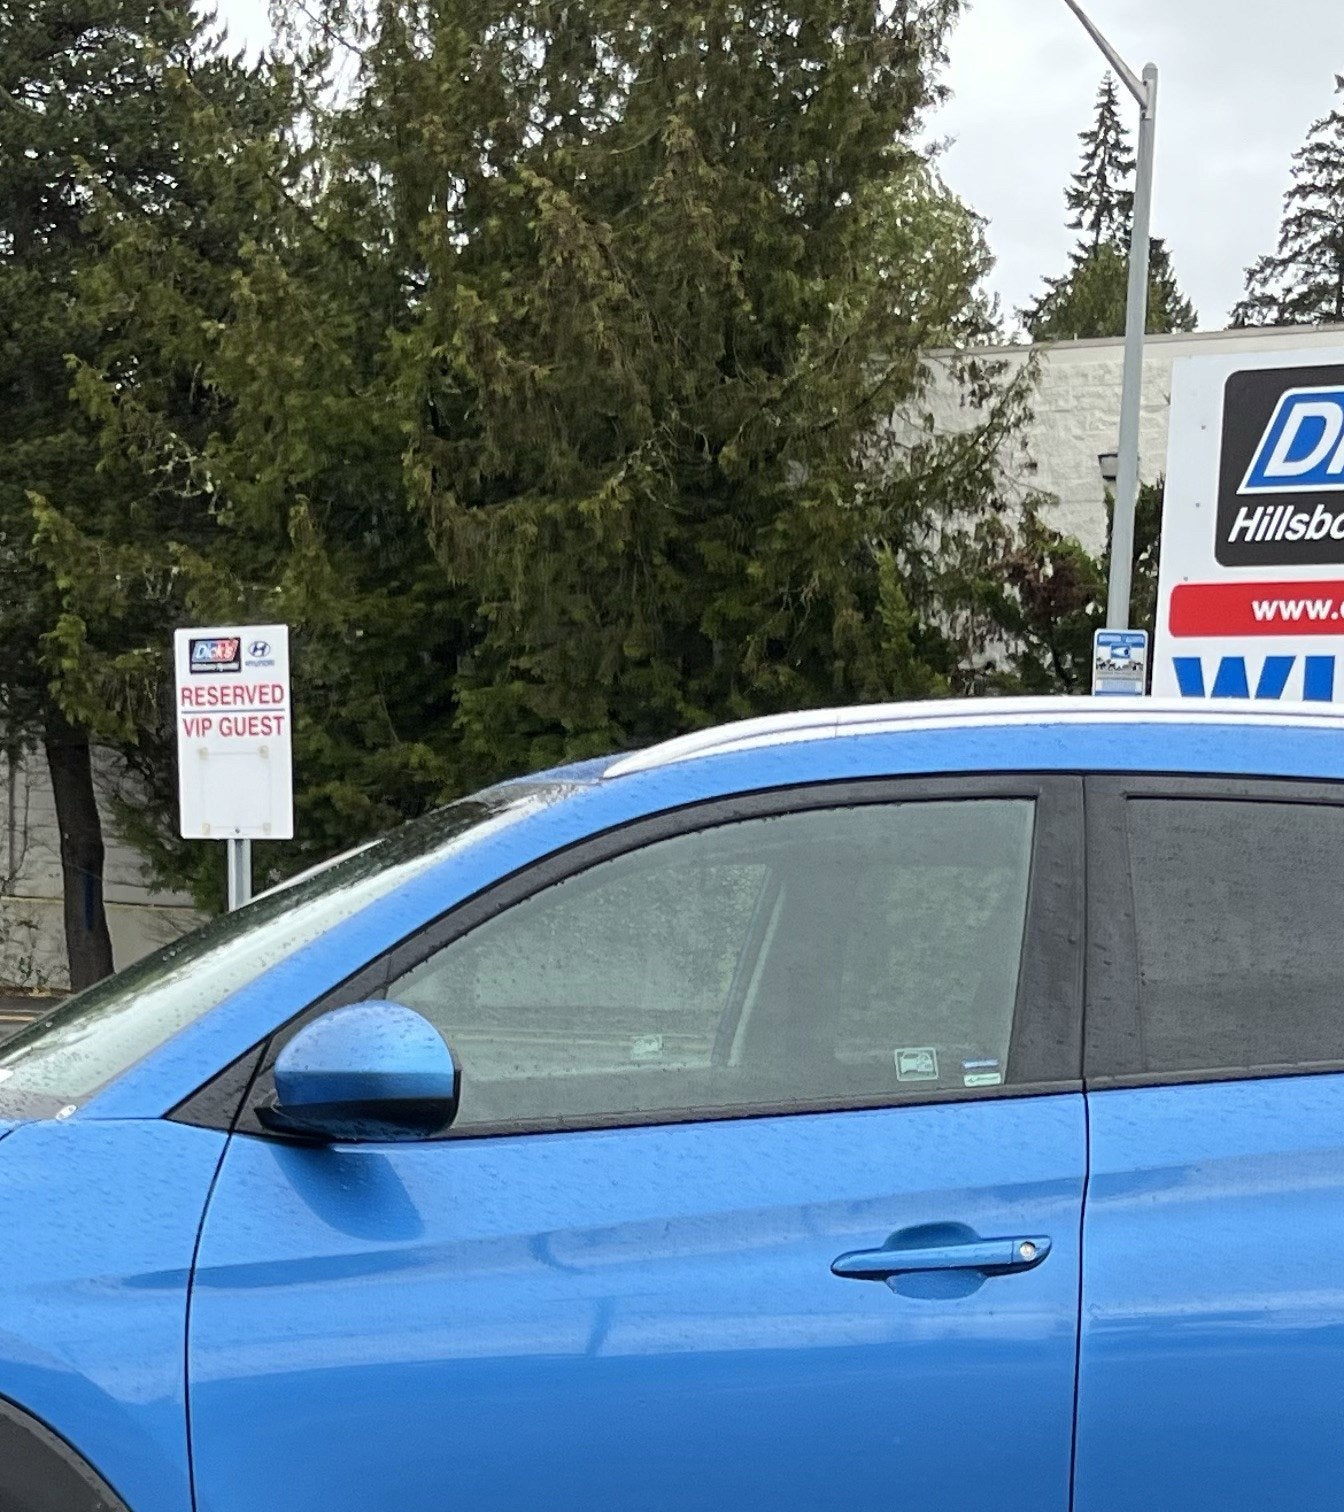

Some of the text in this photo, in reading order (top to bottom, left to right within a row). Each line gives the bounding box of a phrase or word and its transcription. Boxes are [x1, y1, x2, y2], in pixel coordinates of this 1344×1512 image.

[180, 684, 285, 706] RESERVED
[183, 716, 285, 738] VIP GUEST
